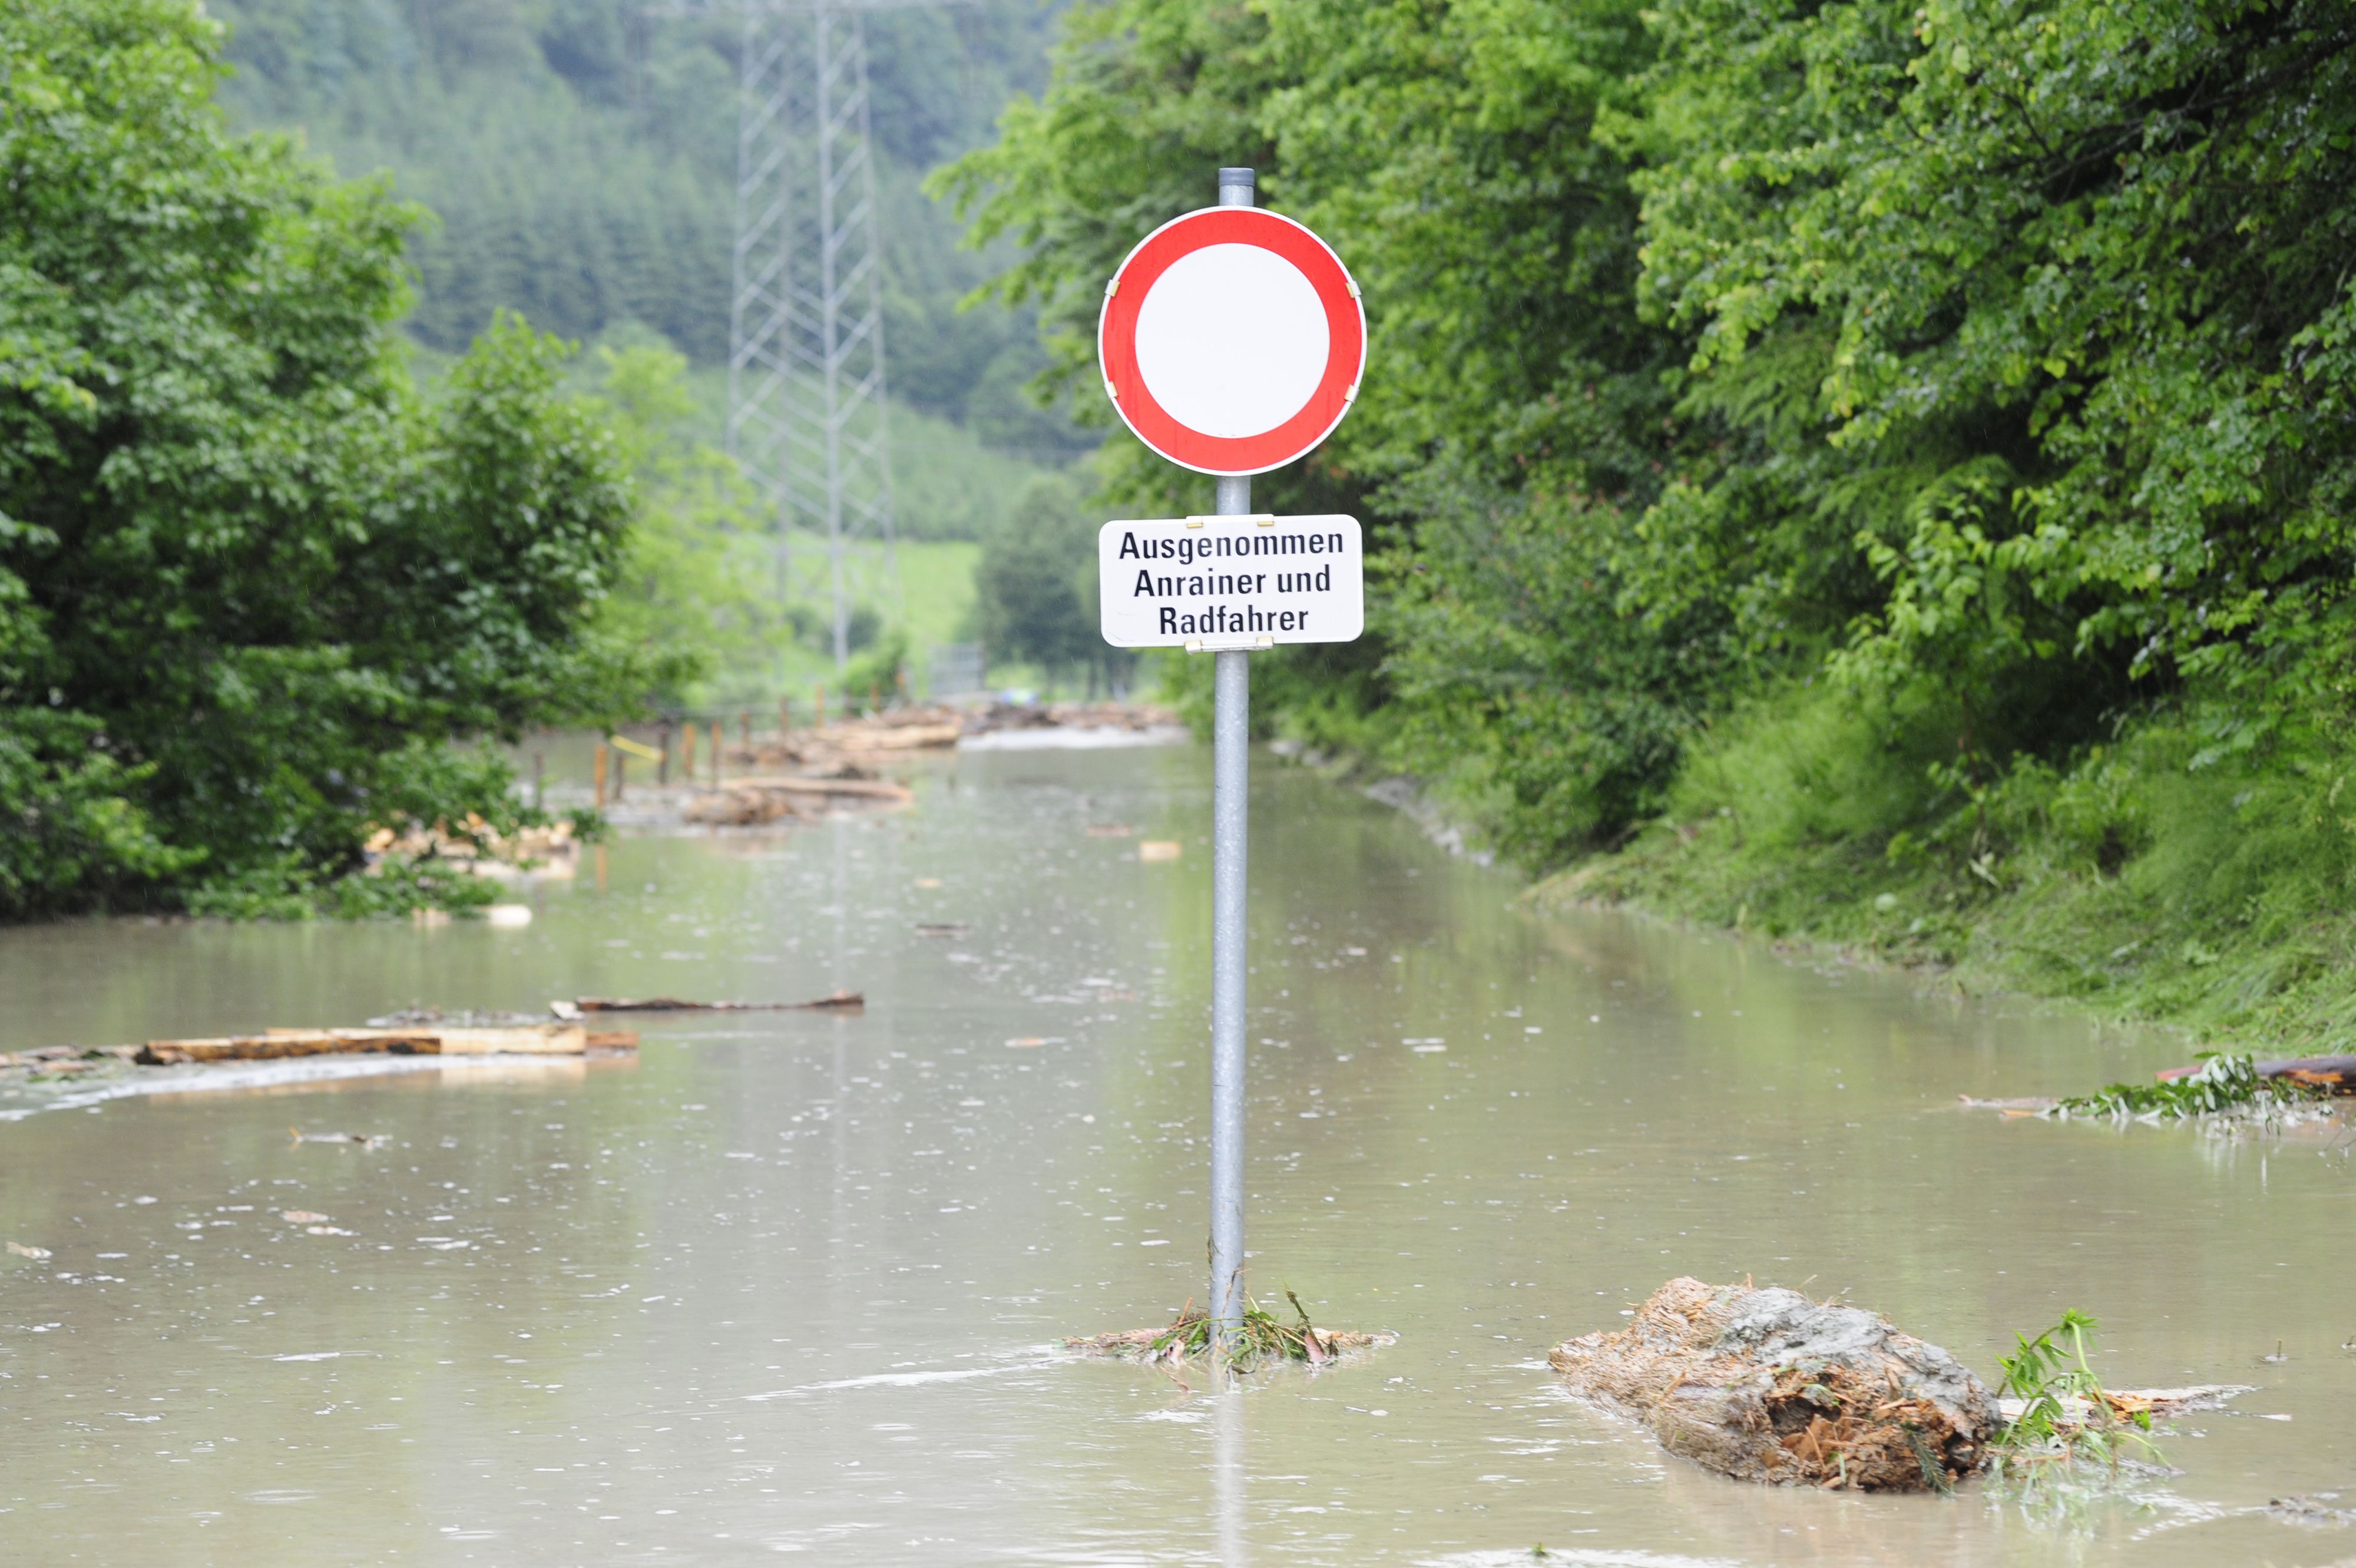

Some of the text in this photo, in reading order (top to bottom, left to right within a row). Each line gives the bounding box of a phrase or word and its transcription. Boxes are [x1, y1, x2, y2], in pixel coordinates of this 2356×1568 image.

[1119, 532, 1343, 565] Ausgenommen
[1134, 564, 1331, 597] Anrainer und
[1160, 604, 1309, 635] Radfahrer
